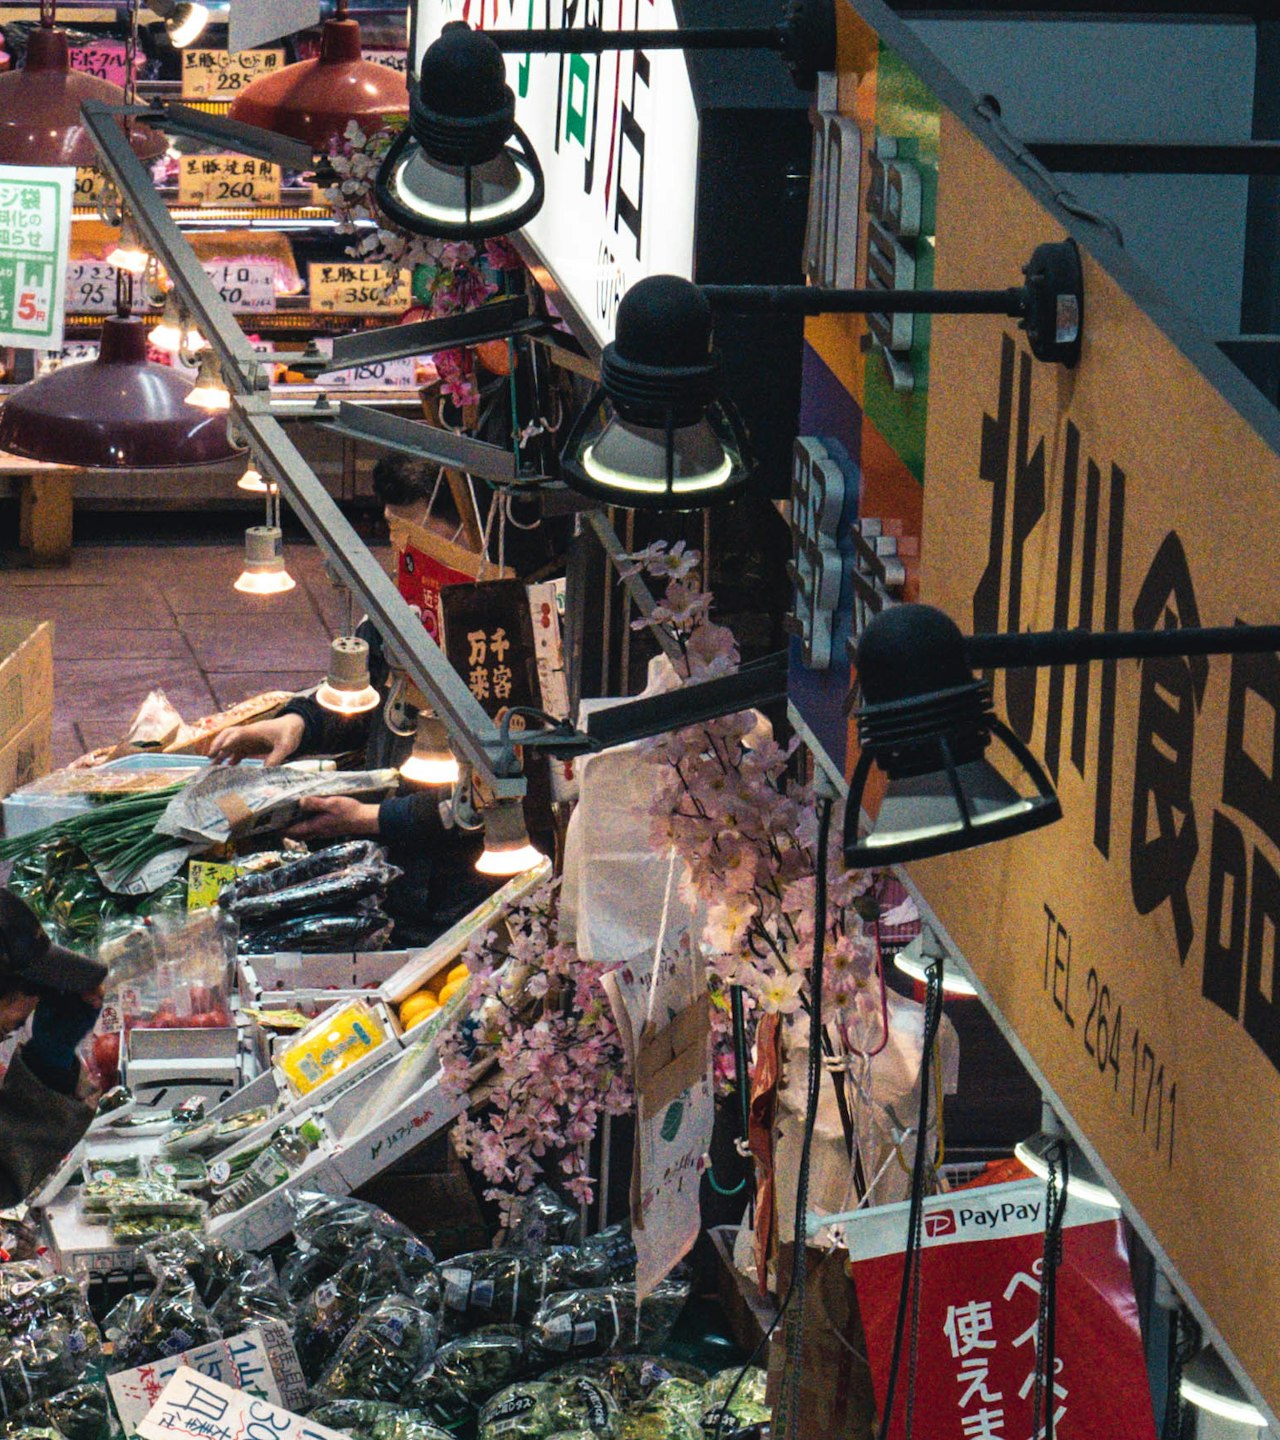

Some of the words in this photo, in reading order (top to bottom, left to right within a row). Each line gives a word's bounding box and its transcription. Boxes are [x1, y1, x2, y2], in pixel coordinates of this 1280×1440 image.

[18, 293, 45, 321] 5円
[1044, 904, 1075, 1030] TEL
[1085, 966, 1122, 1080] 264
[1131, 1031, 1178, 1168] 1711
[960, 1198, 1042, 1230] PayPay
